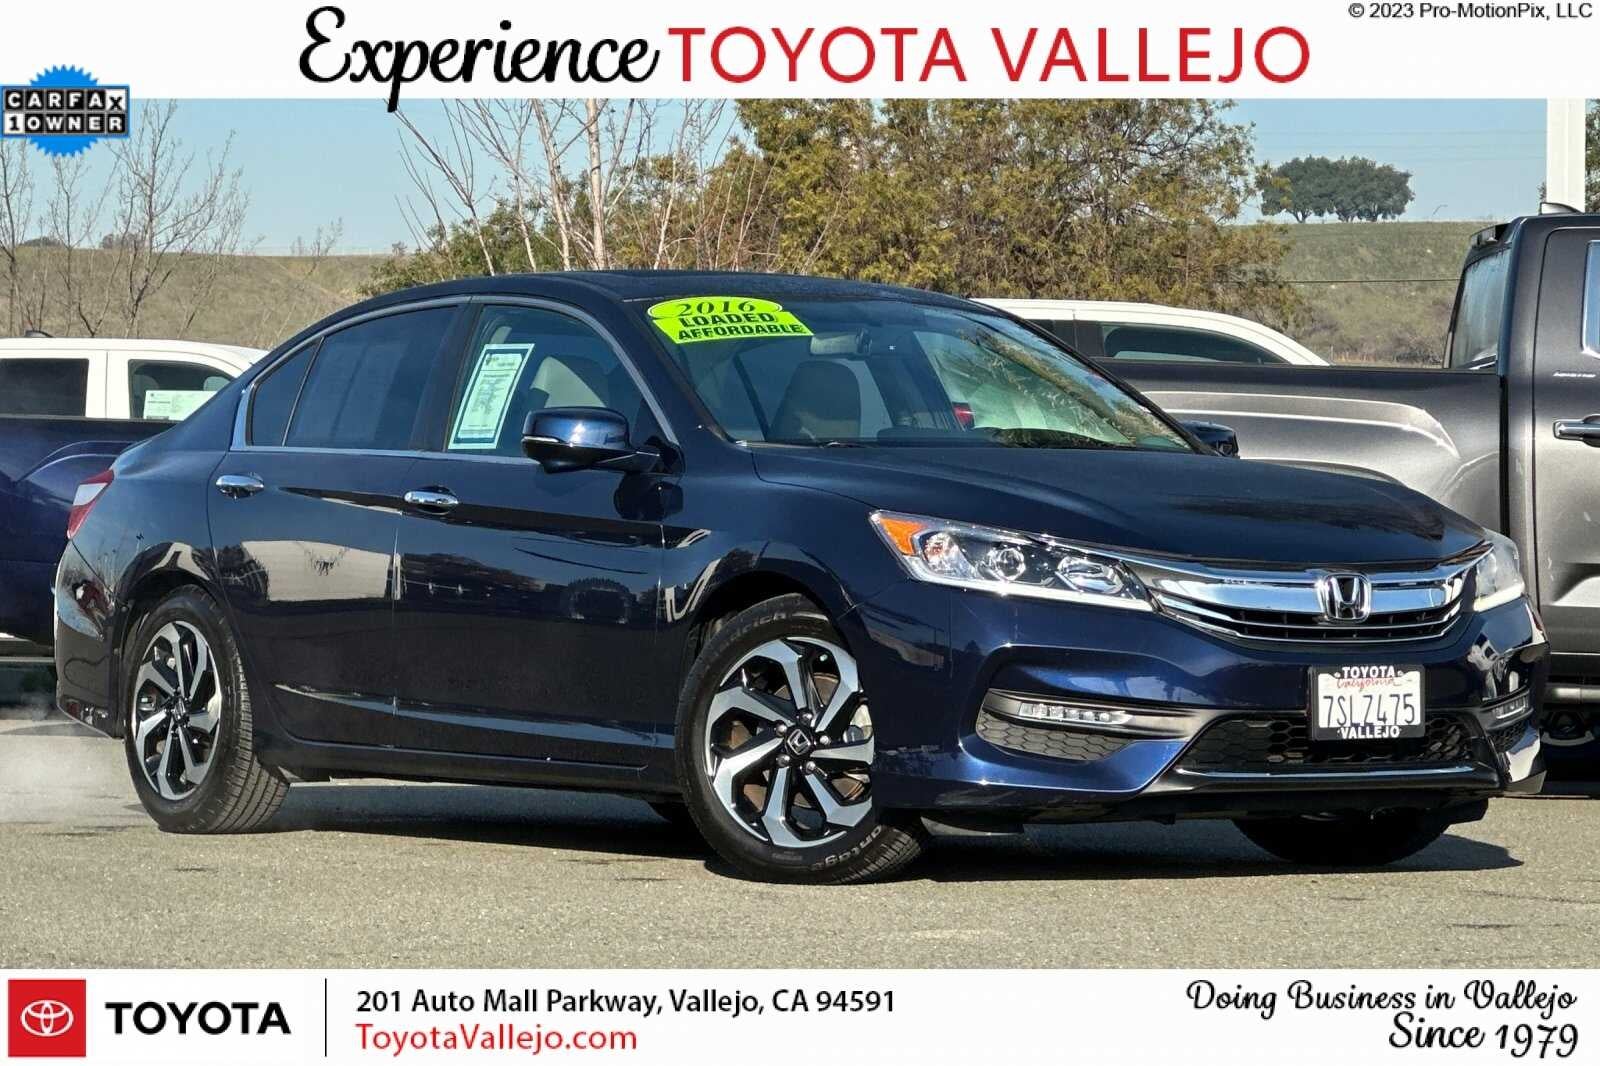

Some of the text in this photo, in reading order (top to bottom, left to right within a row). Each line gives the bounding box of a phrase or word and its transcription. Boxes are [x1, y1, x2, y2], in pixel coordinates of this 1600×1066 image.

[678, 300, 756, 317] 2016
[678, 312, 775, 328] LOADED
[677, 324, 805, 341] AFFORDABLE
[1341, 665, 1396, 679] TOYOTA
[1322, 692, 1416, 727] 7SLZ475
[1340, 725, 1401, 740] VALLEJO
